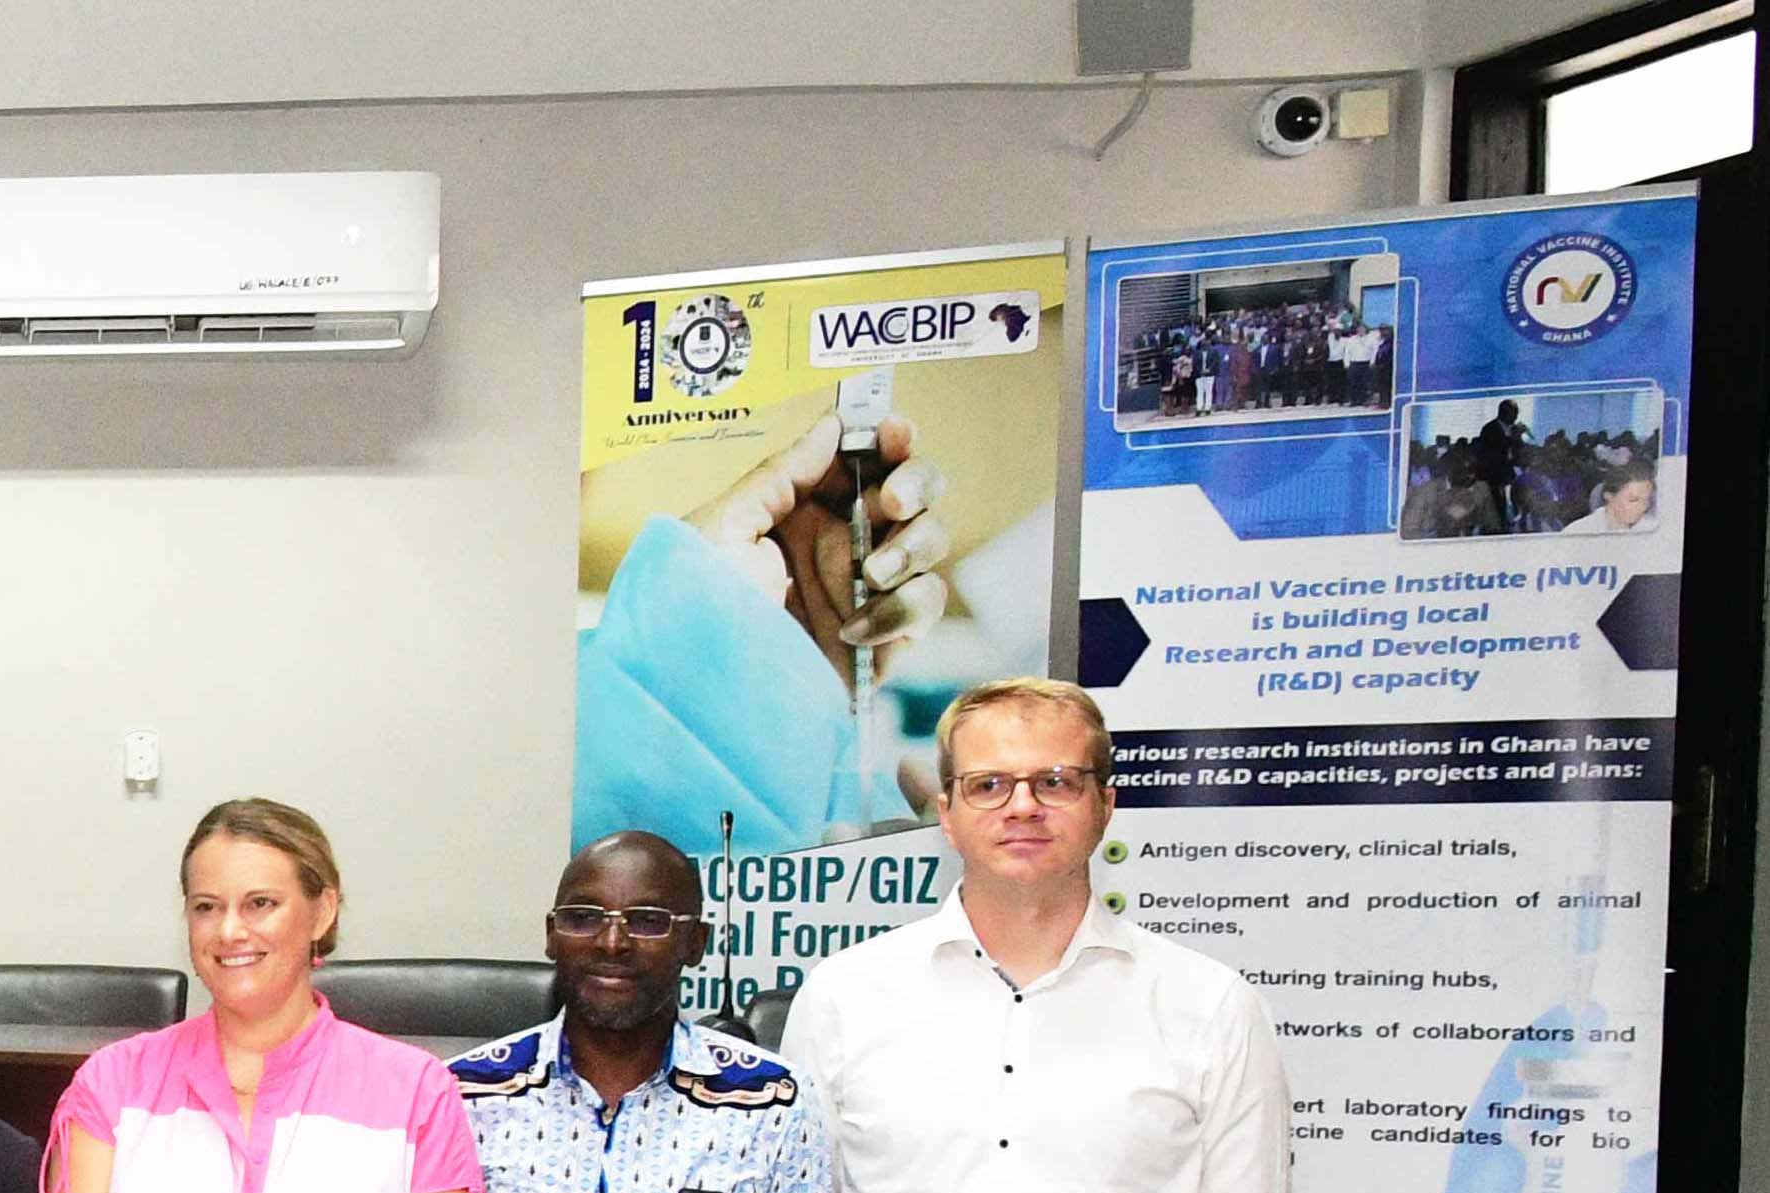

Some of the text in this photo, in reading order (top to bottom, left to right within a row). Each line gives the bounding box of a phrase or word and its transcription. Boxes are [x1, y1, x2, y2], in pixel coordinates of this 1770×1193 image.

[1506, 236, 1631, 313] NATIONAL VACCINE INSTITUTE
[1542, 330, 1592, 341] GHANA
[639, 358, 650, 389] 2014
[623, 407, 751, 427] Anniversary
[1135, 566, 1618, 605] National Vaccine Institute (NVI)
[1252, 603, 1489, 631] is building local
[1165, 632, 1581, 664] Research and Development
[1258, 667, 1480, 697] (R&D) capacity
[1194, 742, 1299, 761] research
[1305, 738, 1453, 758] institutions
[1459, 737, 1483, 754] in
[1491, 736, 1577, 753] Ghana
[1585, 734, 1651, 751] have
[1197, 768, 1252, 786] R&D
[1257, 766, 1388, 788] capacities,
[1394, 764, 1499, 787] projects
[1504, 762, 1555, 779] and
[1561, 761, 1643, 783] plans:
[1139, 839, 1517, 861] Antigen discovery, clinical trials,
[1139, 891, 1642, 912] Development and production of animal
[1239, 969, 1498, 991] cturing training hubs,
[1376, 1022, 1399, 1039] of
[1413, 1023, 1574, 1042] collaborators
[1589, 1026, 1636, 1042] and
[1345, 1098, 1467, 1121] laboratory
[1488, 1102, 1585, 1125] findings
[1609, 1107, 1632, 1122] to
[1290, 1123, 1630, 1149] cine candidates for bio
